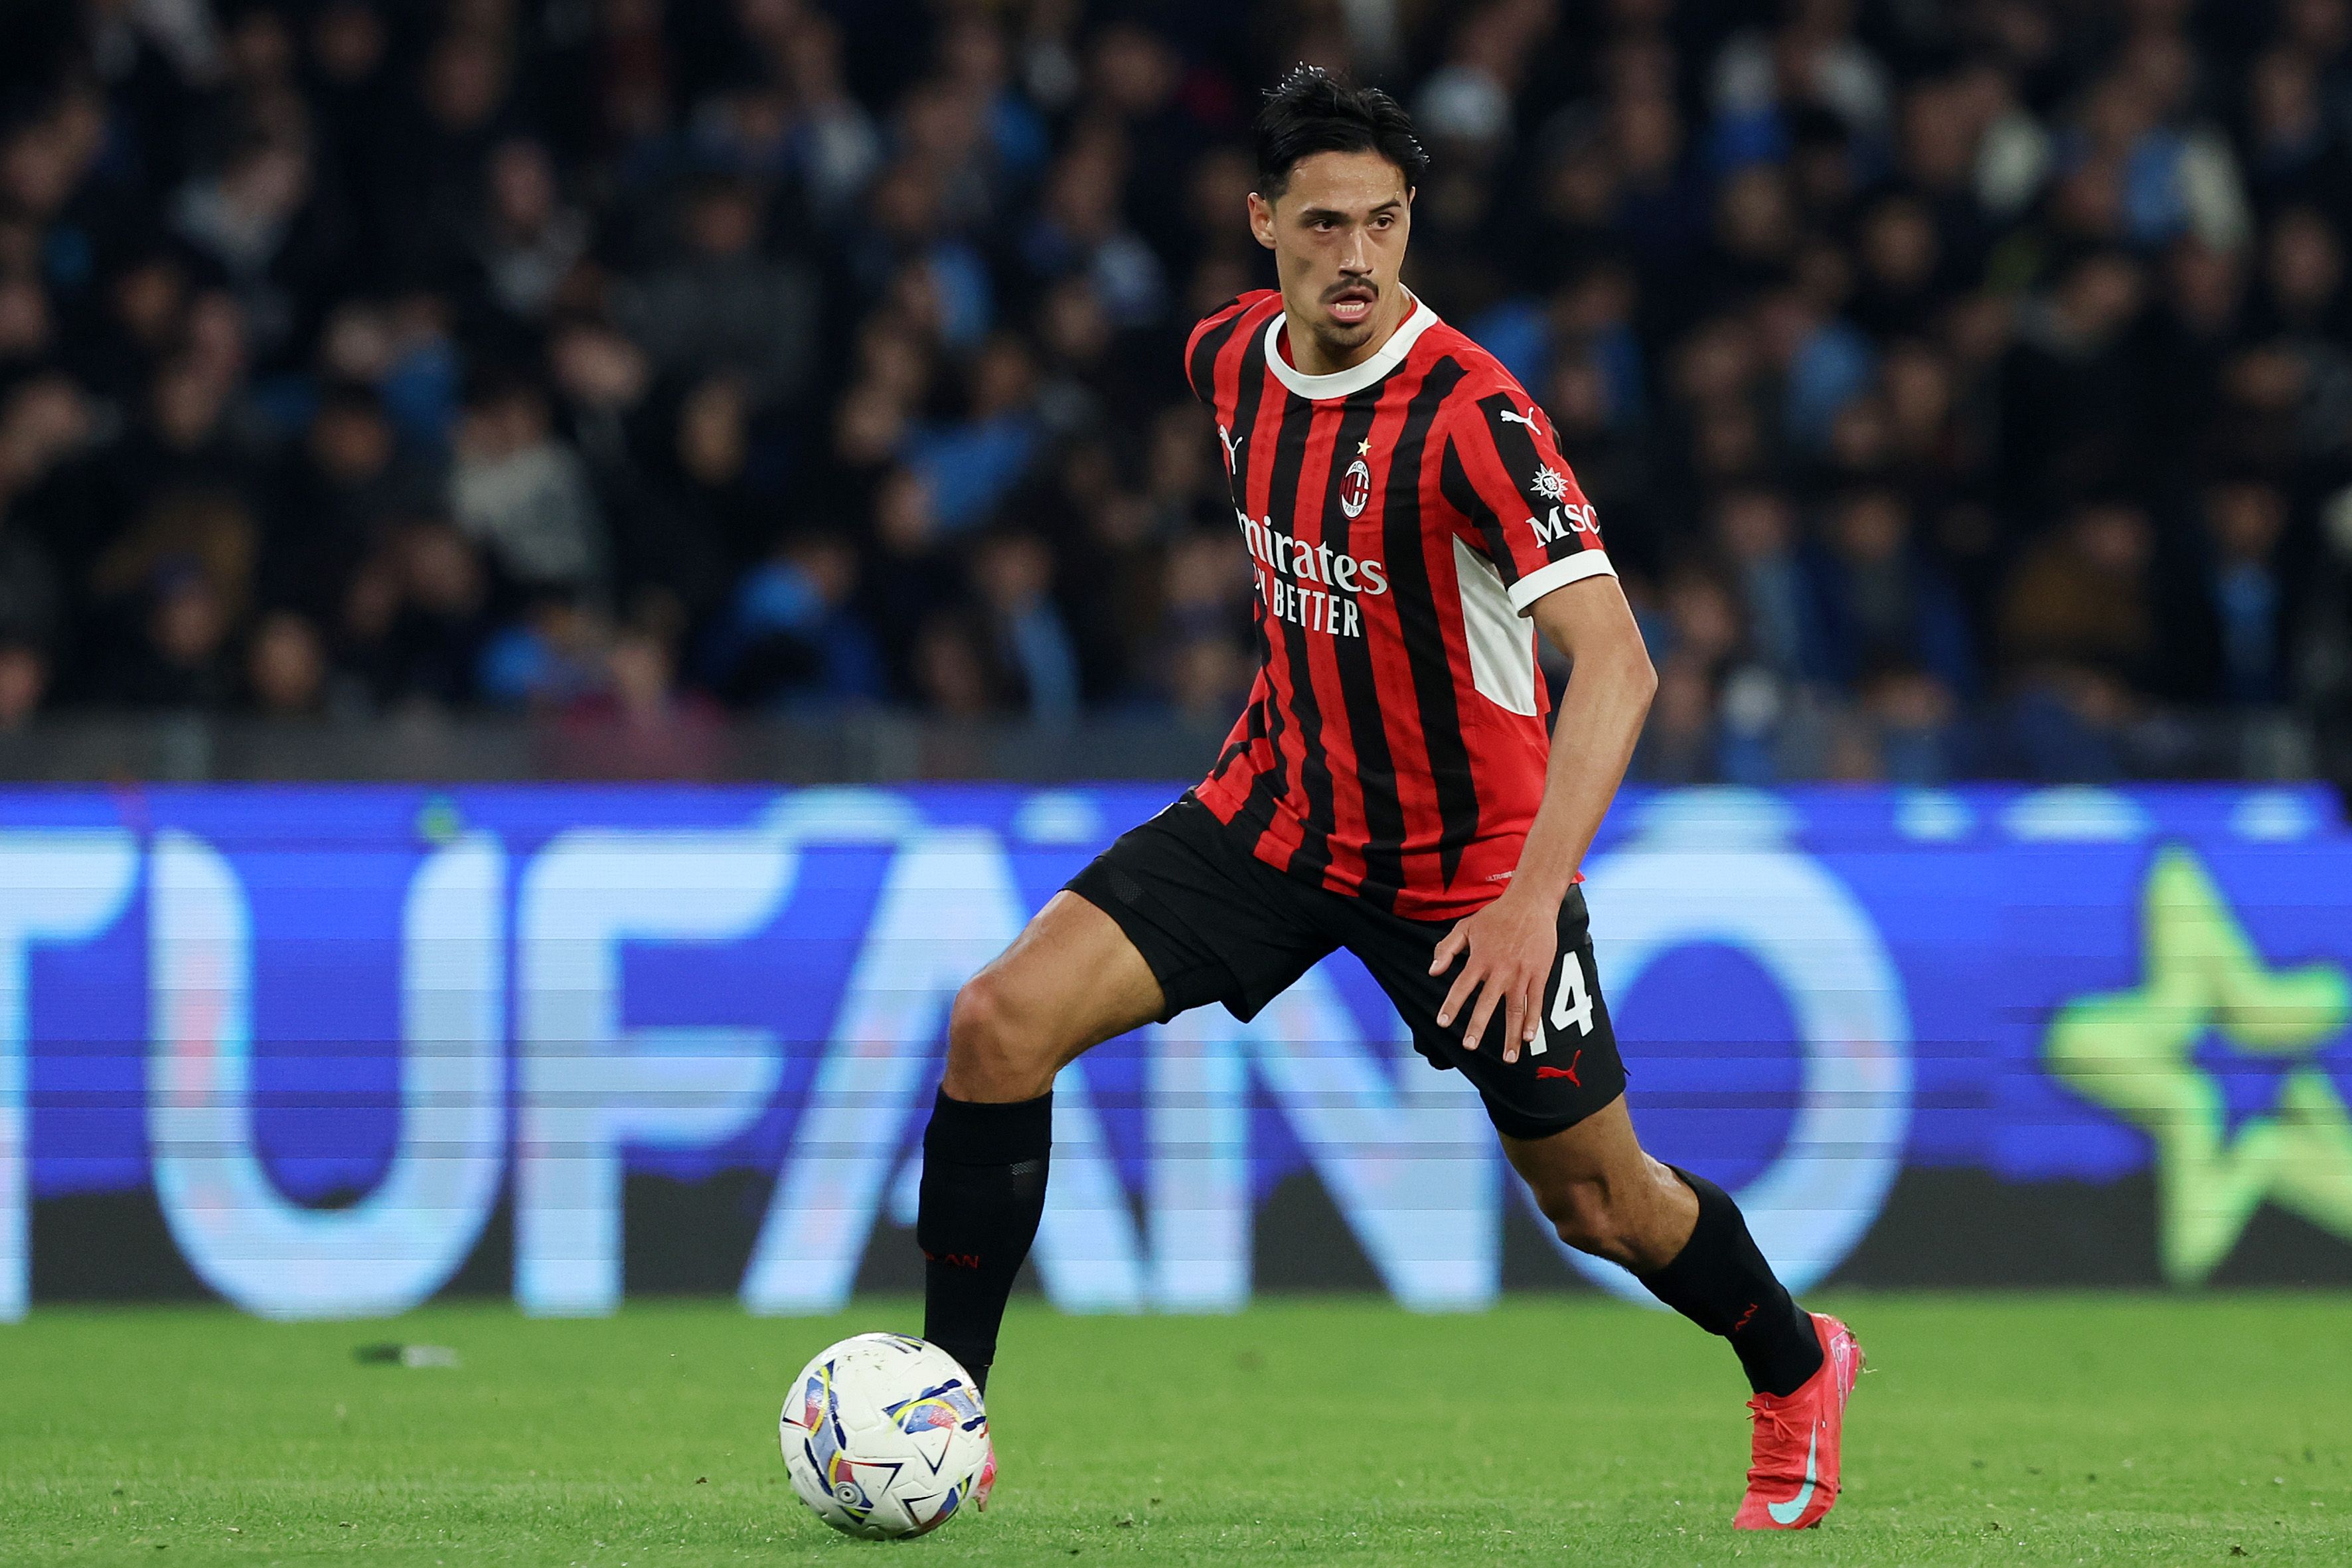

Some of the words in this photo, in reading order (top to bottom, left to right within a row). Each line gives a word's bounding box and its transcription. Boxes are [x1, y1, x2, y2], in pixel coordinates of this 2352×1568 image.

[1345, 505, 1360, 513] 1899
[1526, 504, 1601, 548] MSC
[1273, 577, 1360, 638] BETTER
